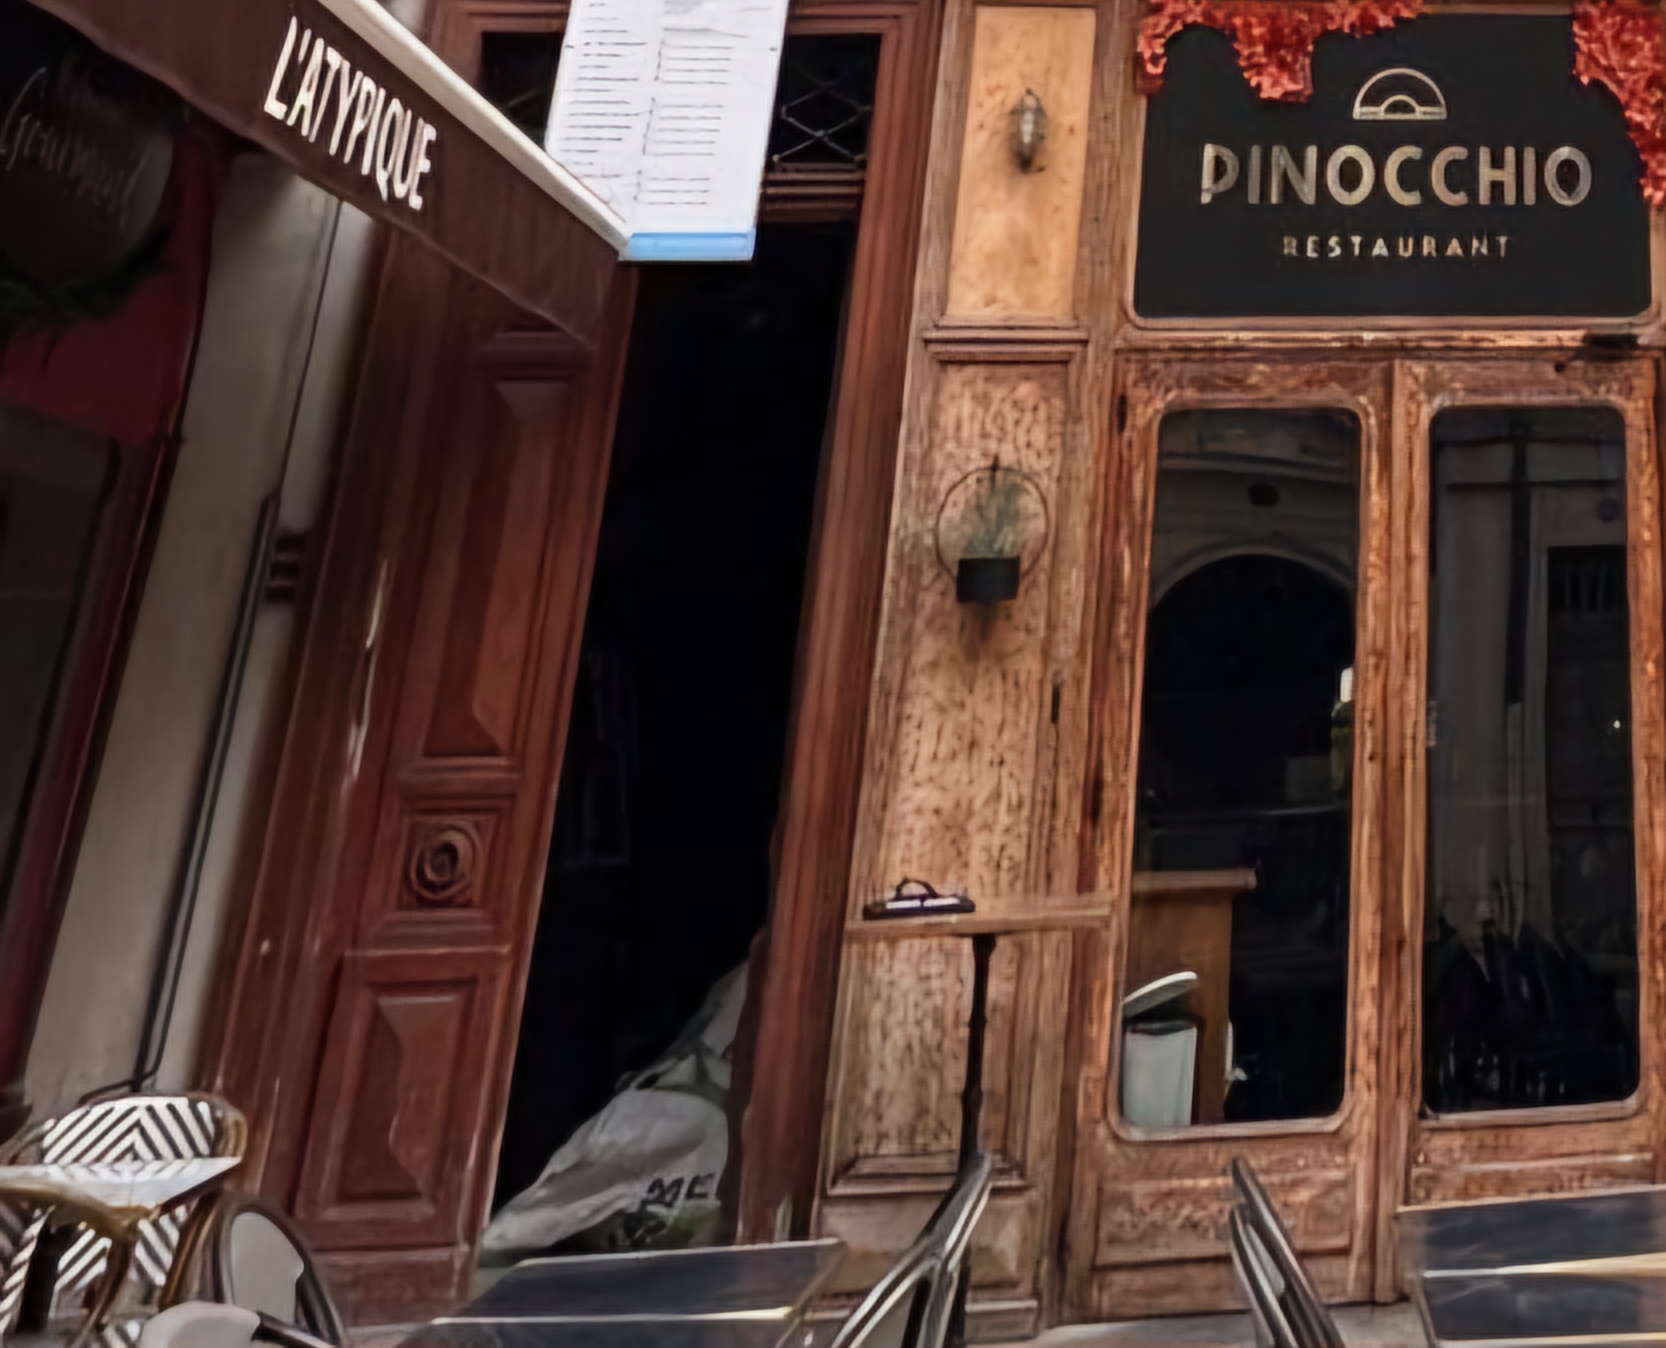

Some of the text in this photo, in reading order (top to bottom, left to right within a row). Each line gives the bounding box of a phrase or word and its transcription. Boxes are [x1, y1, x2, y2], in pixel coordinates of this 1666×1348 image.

[264, 15, 437, 211] L'ATYPIQUE
[1200, 142, 1593, 207] PINOCCHIO
[1282, 234, 1510, 259] RESTAURANT
